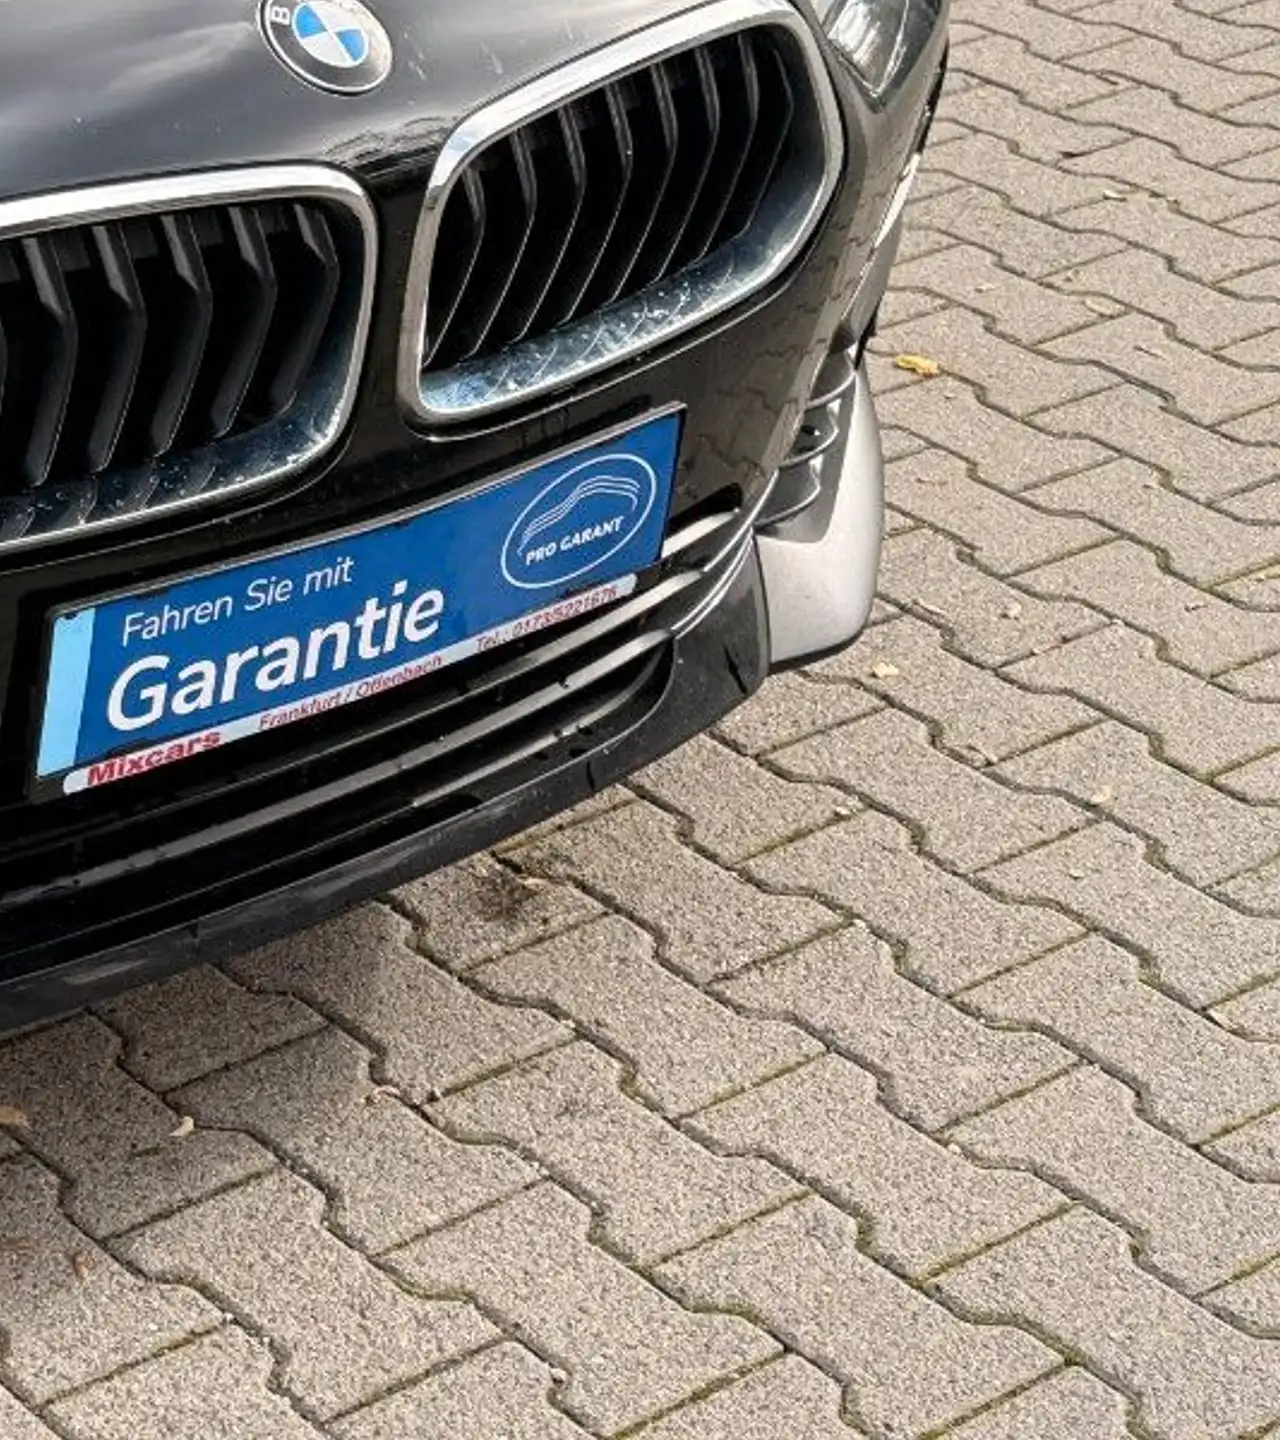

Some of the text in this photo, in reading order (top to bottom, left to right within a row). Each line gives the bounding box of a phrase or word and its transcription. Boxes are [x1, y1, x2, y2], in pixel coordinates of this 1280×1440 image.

[525, 515, 625, 566] PRO GARANT
[122, 556, 355, 647] Fahren Sie mit
[106, 579, 445, 732] Garantie
[87, 731, 221, 787] Mixcars
[259, 691, 341, 729] Frankfurt
